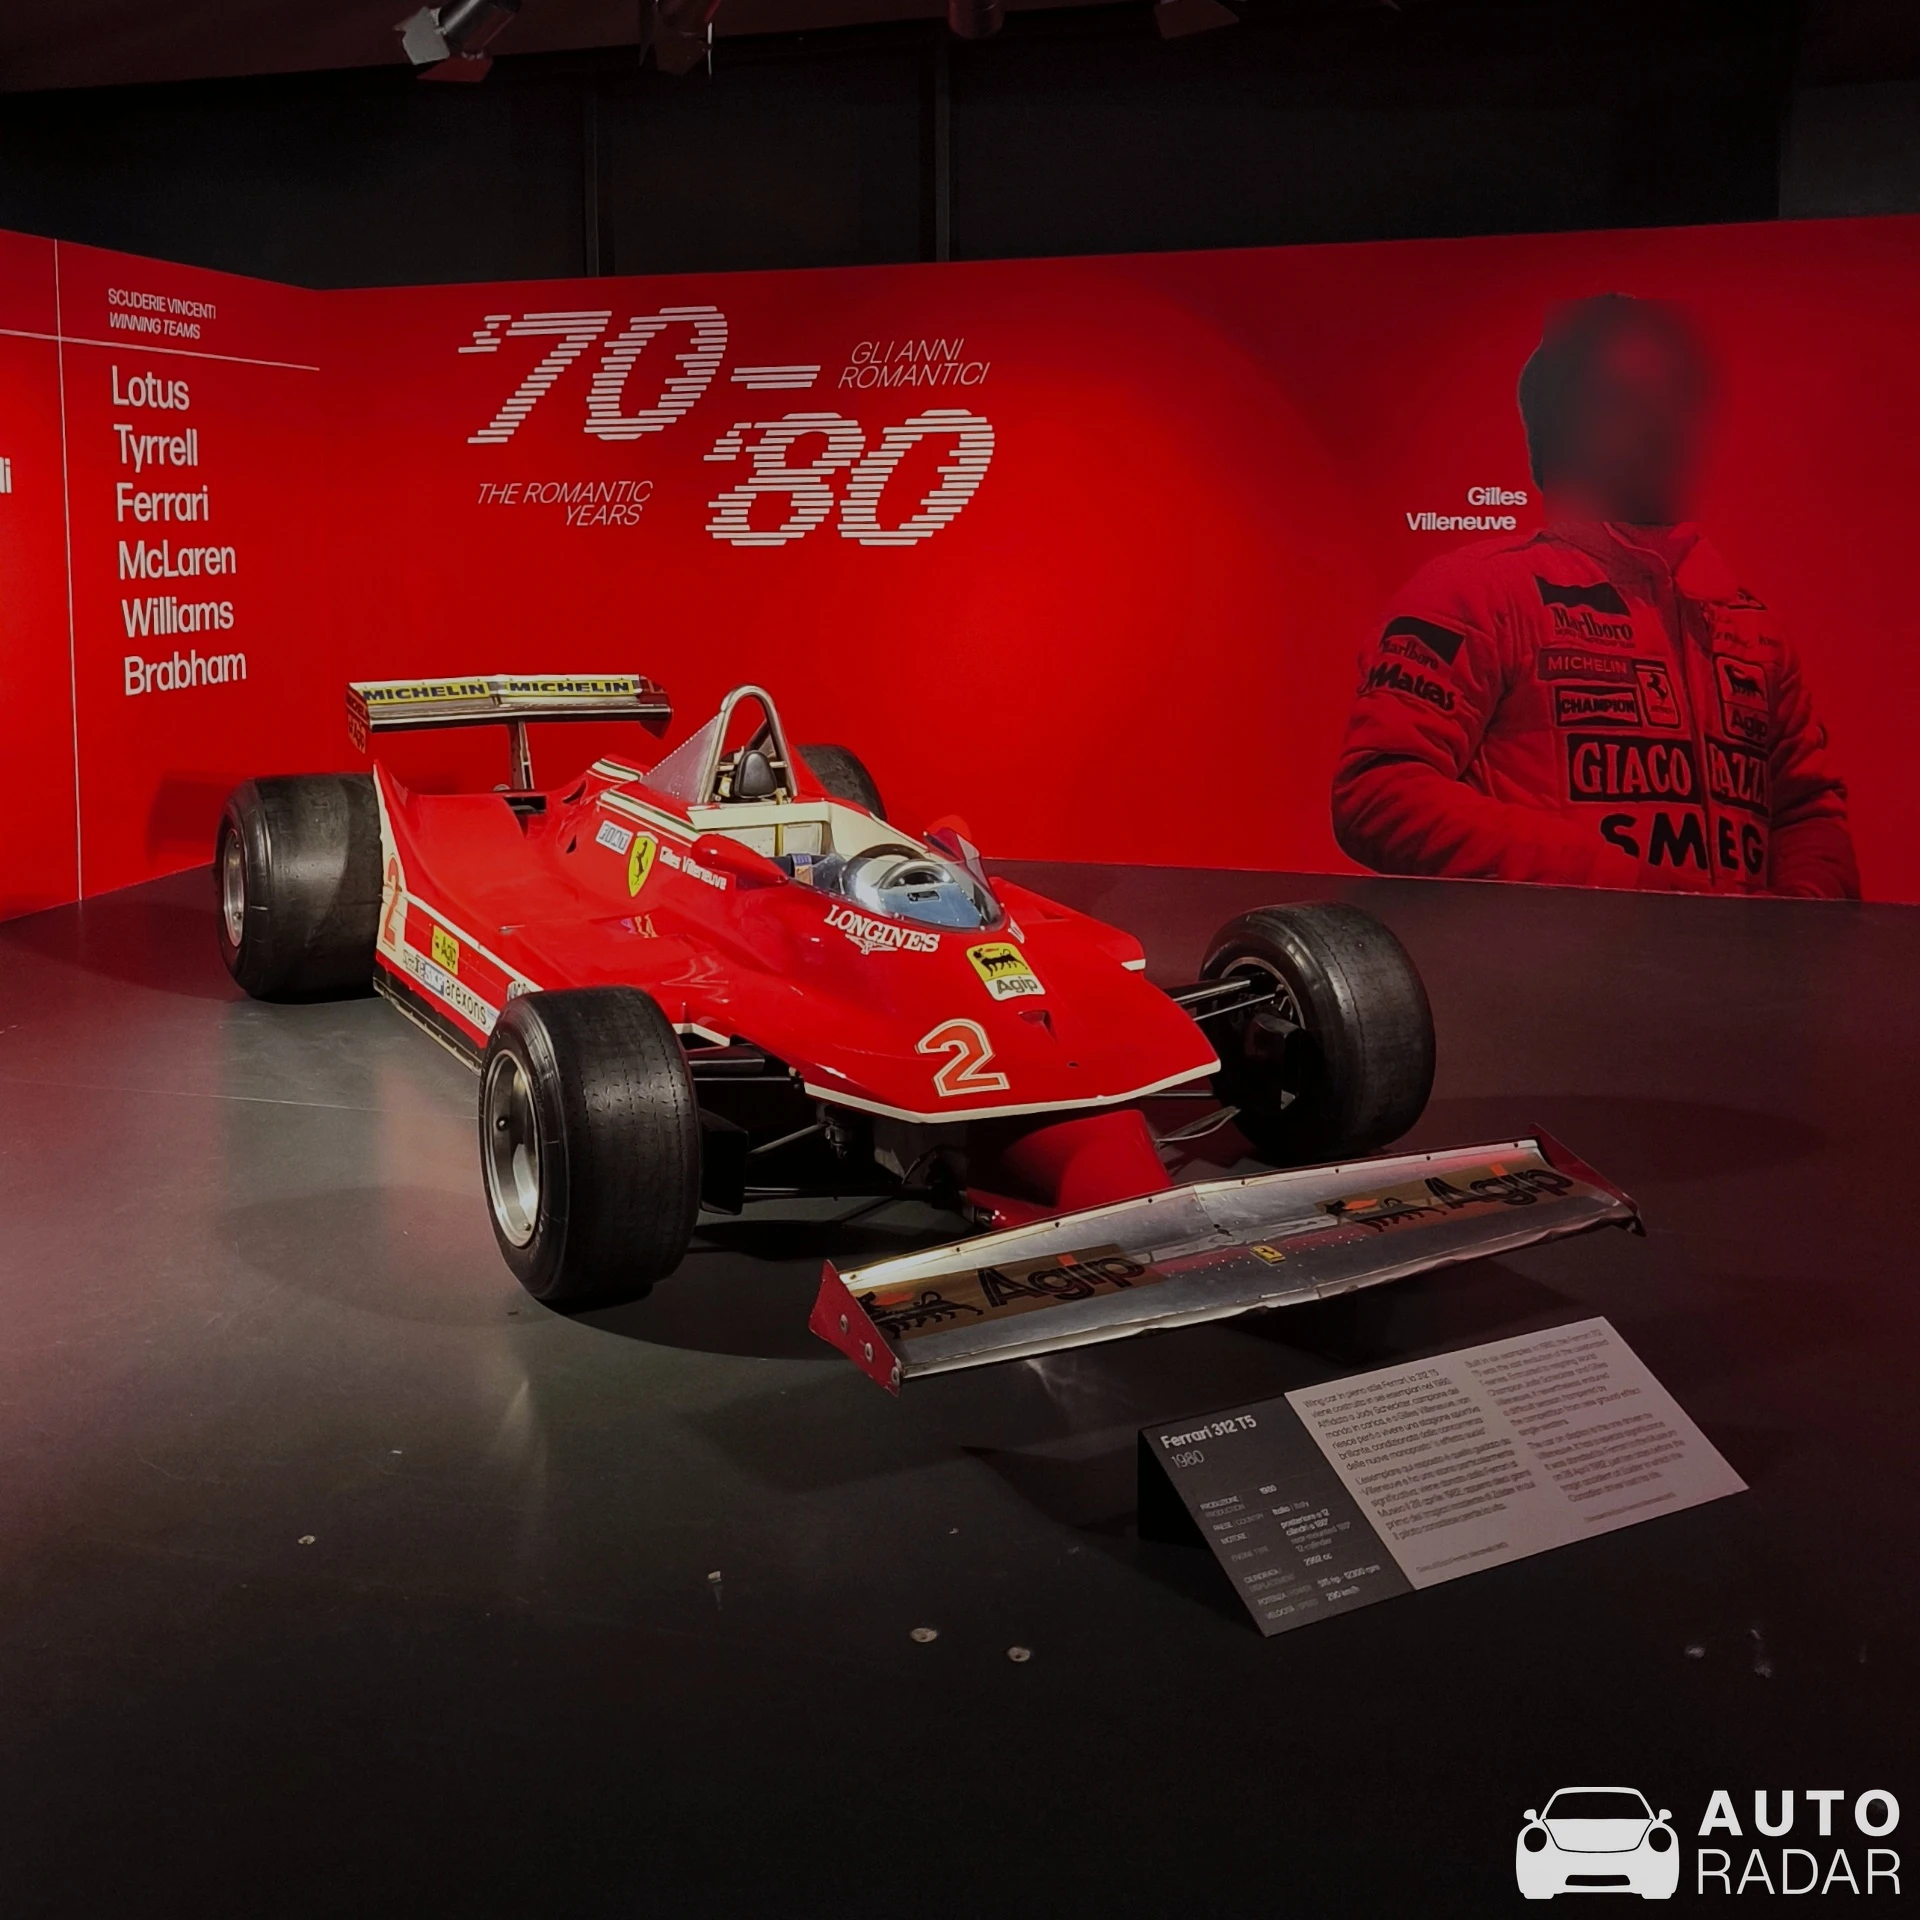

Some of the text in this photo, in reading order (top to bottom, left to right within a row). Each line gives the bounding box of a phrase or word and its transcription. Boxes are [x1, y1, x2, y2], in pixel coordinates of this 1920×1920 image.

[108, 288, 216, 319] SCUDERIE VINCENTI
[109, 312, 201, 339] WINNING TEAMS
[851, 338, 965, 365] GLI ANNI
[112, 366, 189, 410] Lotus
[838, 361, 990, 389] ROMANTICI
[114, 424, 197, 472] Tyrrell
[117, 483, 208, 522] Ferrari
[477, 480, 653, 505] THE ROMANTIC
[1467, 486, 1528, 507] Gilles
[565, 504, 643, 527] YEARS
[1406, 511, 1516, 531] Villeneuve
[119, 540, 236, 580] McLaren
[122, 597, 233, 637] Williams
[1554, 606, 1633, 641] Marlboro
[125, 650, 246, 695] Brabham
[1548, 656, 1627, 674] MICHELIN
[362, 683, 486, 701] MICHELIN
[509, 680, 630, 694] MICHELIN
[1561, 698, 1636, 714] CHAMPION
[1601, 812, 1764, 875] SMEG
[382, 852, 401, 951] 2
[824, 904, 940, 953] LONGINES
[996, 976, 1038, 995] Agip
[446, 979, 487, 1025] arexons
[914, 1017, 1011, 1098] 2
[1425, 1163, 1574, 1210] Agip
[977, 1254, 1146, 1308] Agip
[1160, 1426, 1212, 1448] Ferrari
[1171, 1450, 1205, 1468] 1980
